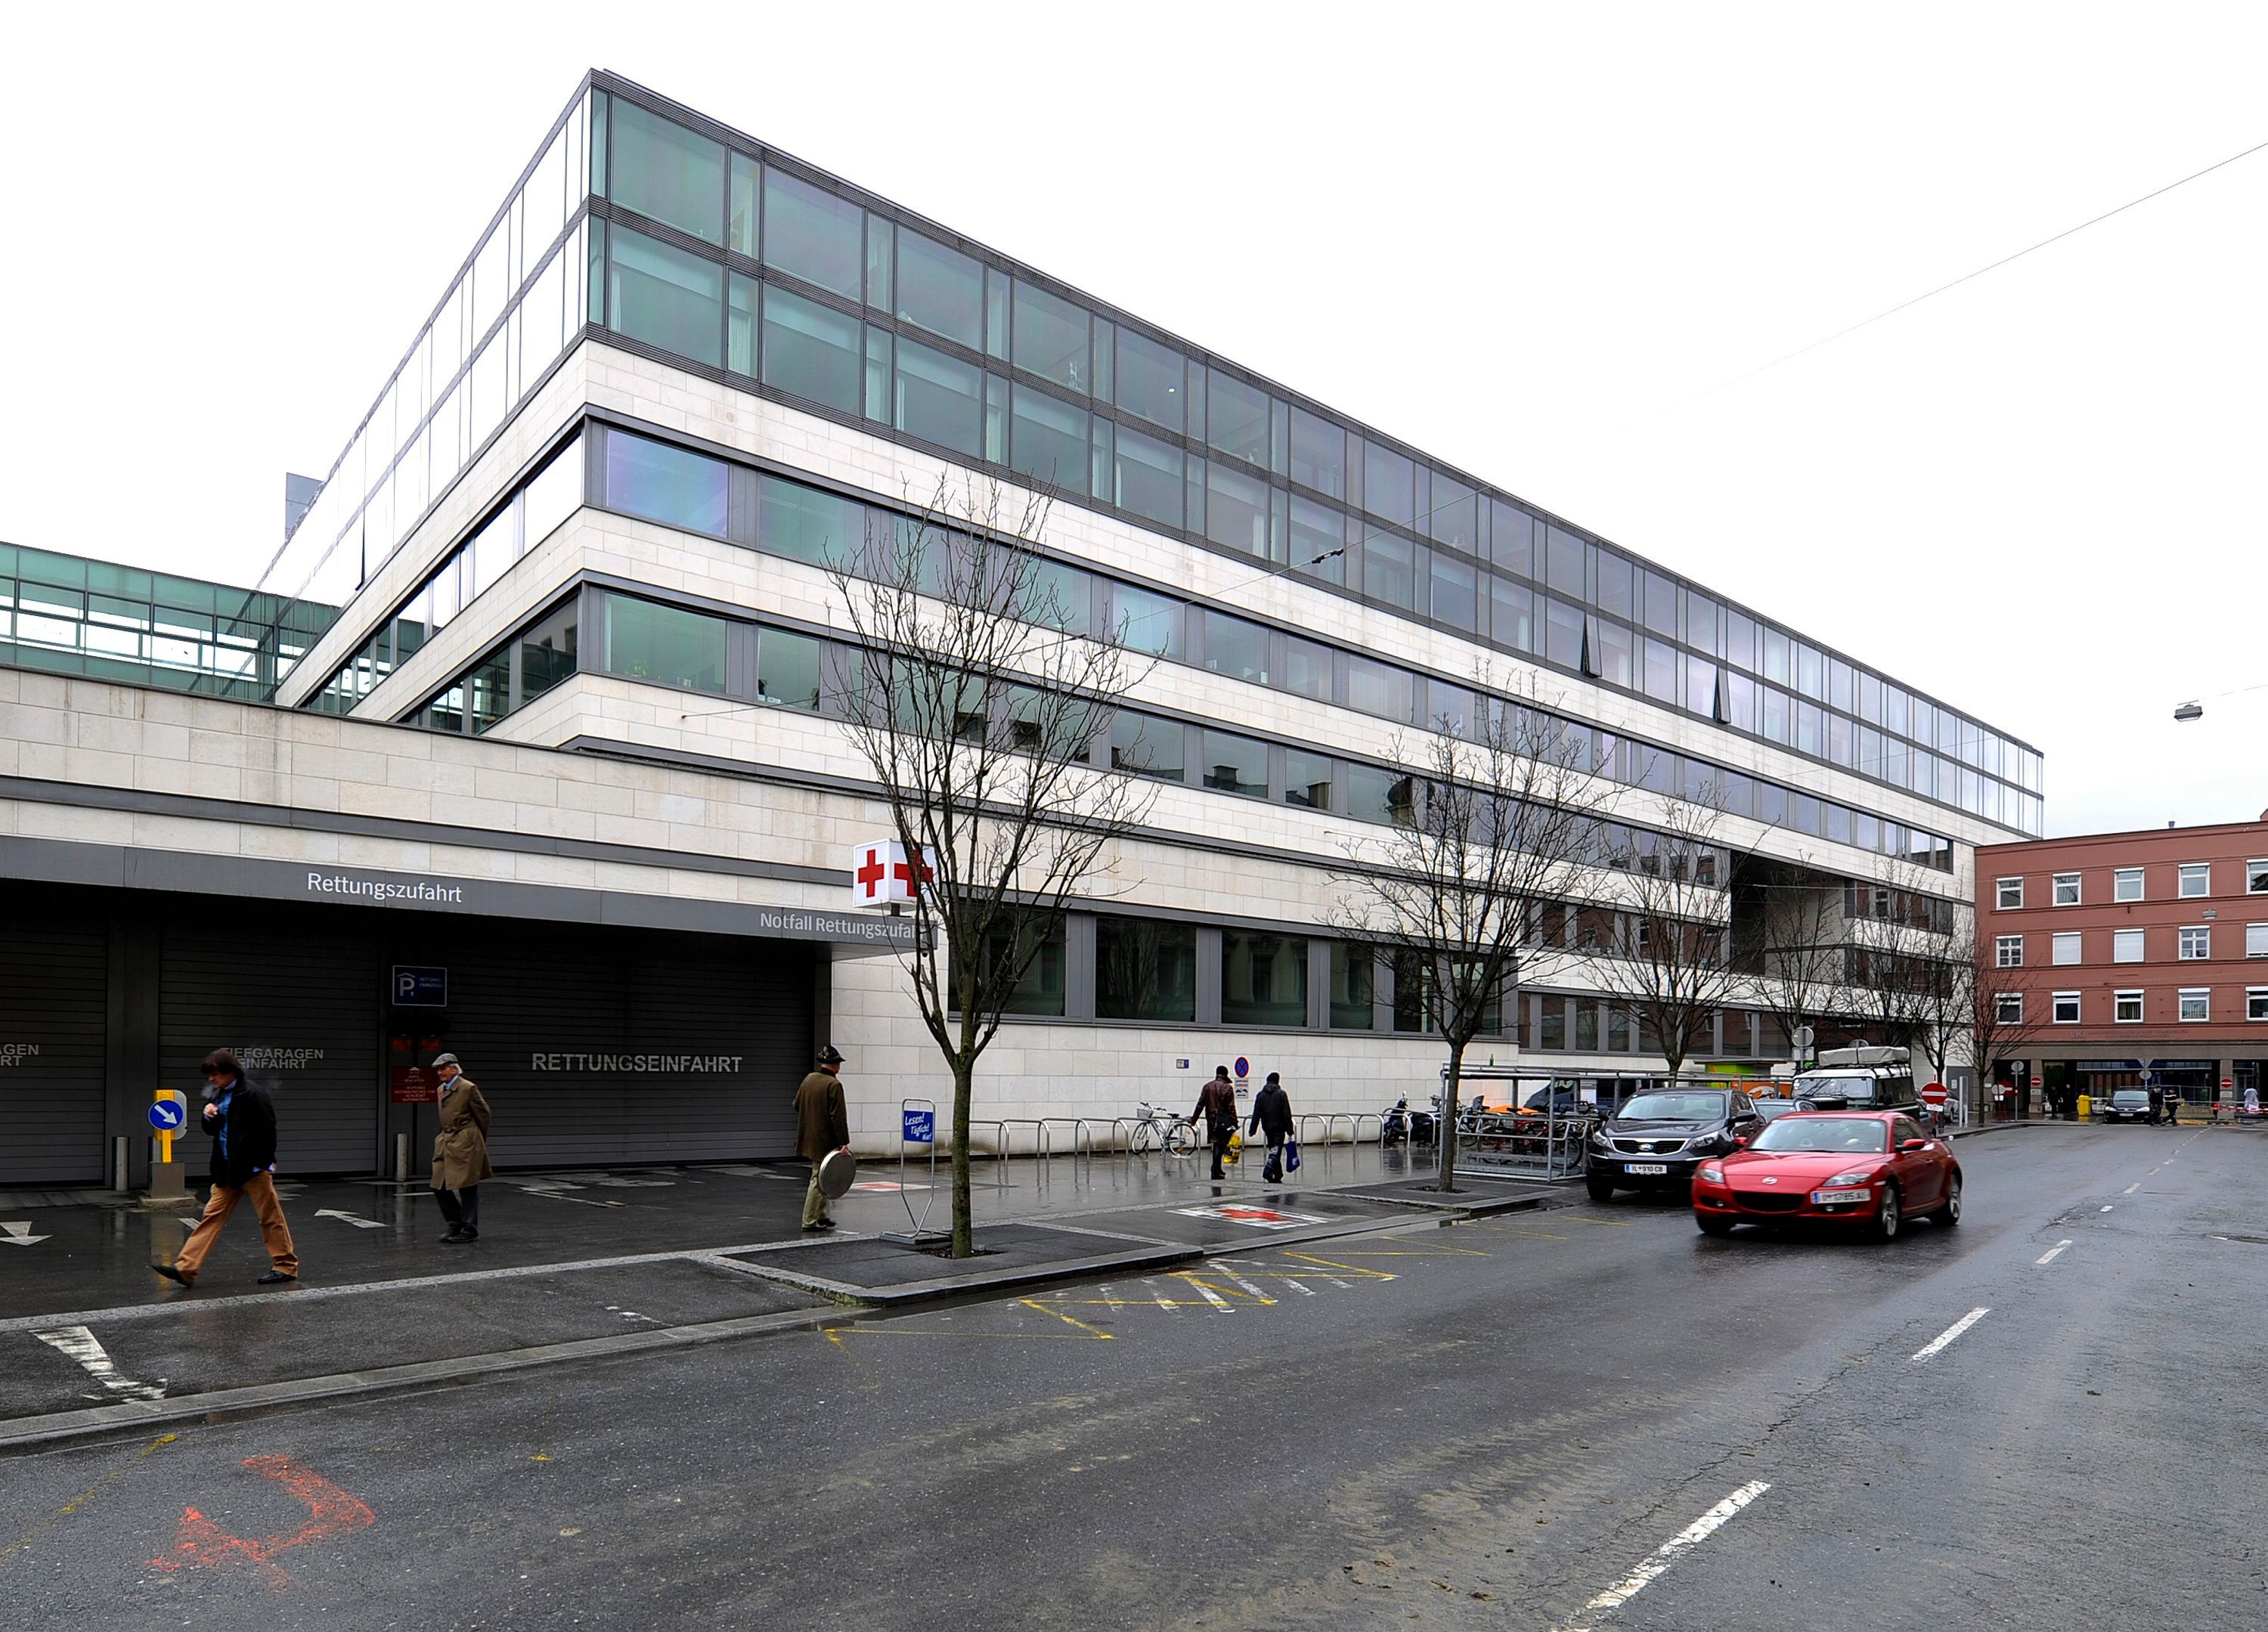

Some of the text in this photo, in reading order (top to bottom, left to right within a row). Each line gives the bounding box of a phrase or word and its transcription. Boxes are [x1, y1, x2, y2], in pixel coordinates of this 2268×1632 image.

[307, 872, 463, 903] Rettungszufahrt
[761, 912, 927, 940] Notfall Rettungszufar
[531, 1052, 743, 1073] RETTUNGSEINFAHRT
[905, 1113, 925, 1126] Lesen!
